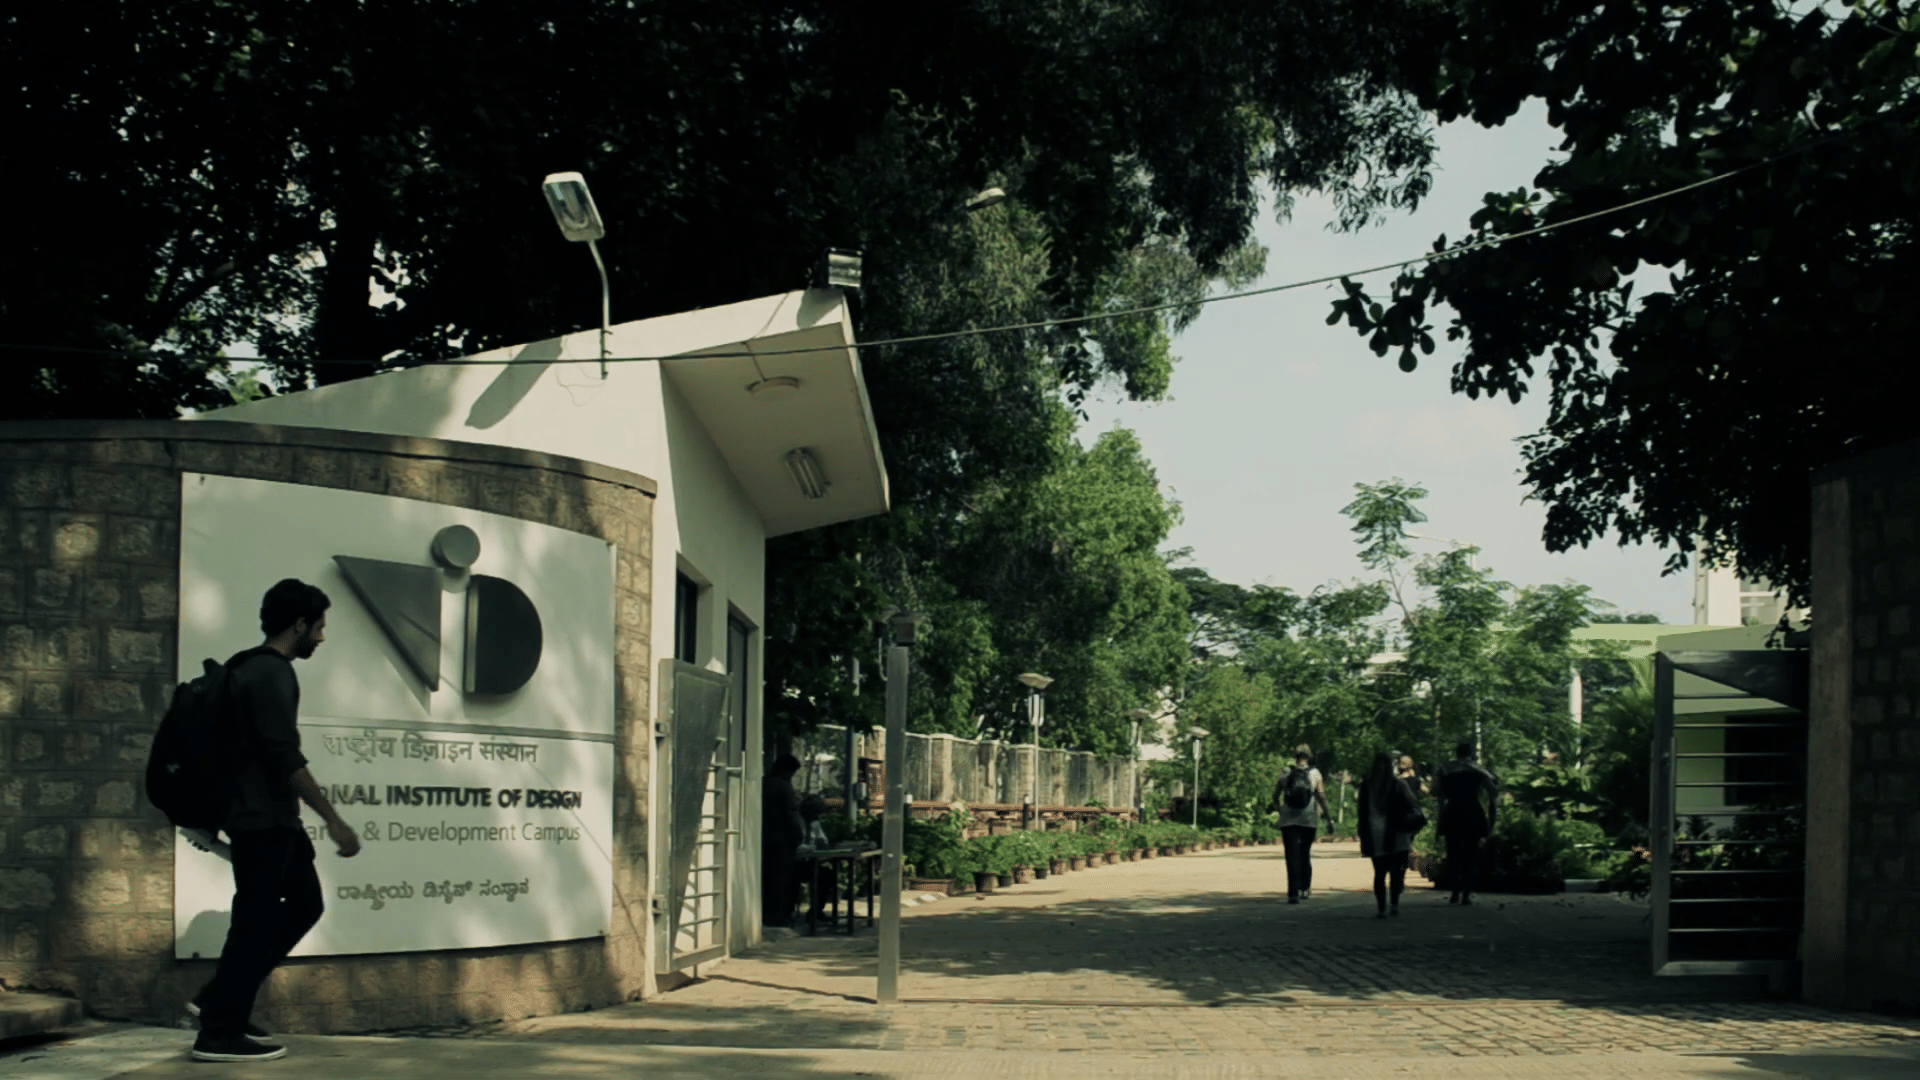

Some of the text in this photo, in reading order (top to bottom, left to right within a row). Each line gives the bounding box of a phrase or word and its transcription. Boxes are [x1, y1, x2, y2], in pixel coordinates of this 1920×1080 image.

[323, 728, 397, 763] राष्ट्रीय
[386, 785, 491, 807] INSTITUTE
[497, 789, 522, 807] OF
[525, 790, 582, 809] DESIGN
[363, 820, 381, 841] &
[388, 820, 516, 845] Development
[522, 823, 580, 845] Campus
